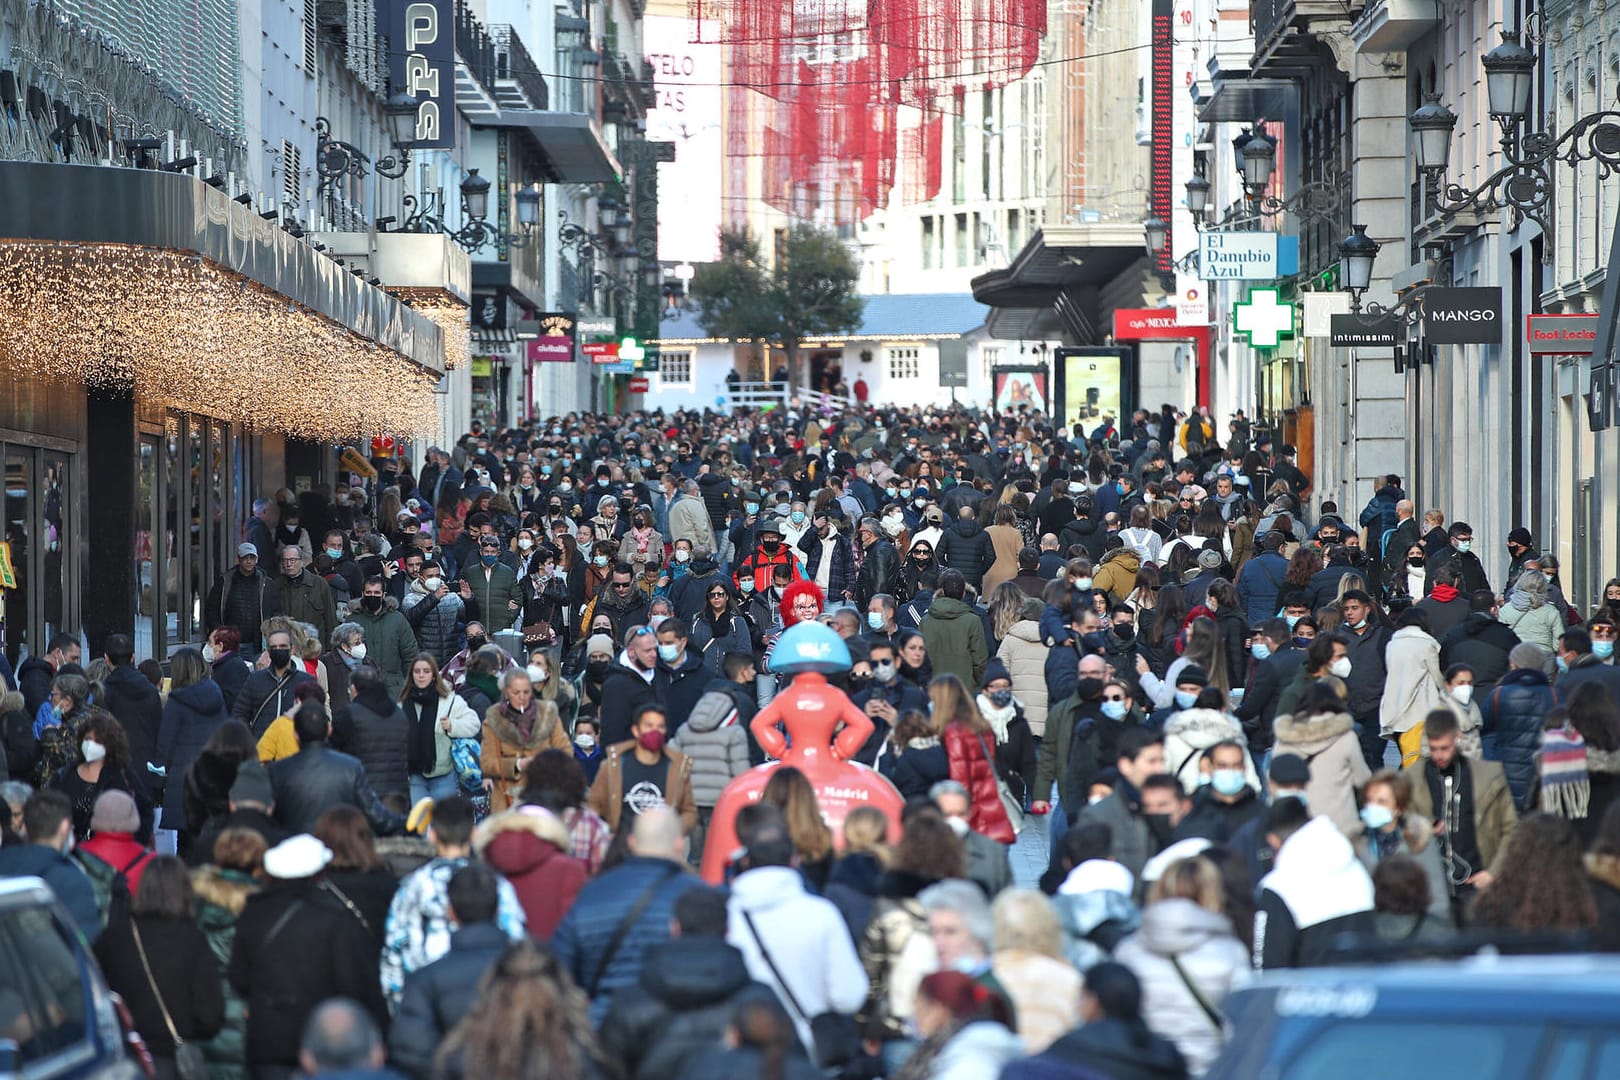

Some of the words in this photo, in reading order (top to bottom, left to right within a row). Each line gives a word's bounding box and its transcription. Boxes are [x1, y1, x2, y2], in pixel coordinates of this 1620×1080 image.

[1181, 10, 1192, 24] 10
[1207, 234, 1223, 248] El
[1207, 249, 1271, 263] Danubio
[1206, 264, 1243, 277] Azul
[1432, 309, 1495, 322] MANGO
[1333, 333, 1394, 343] intimissimi
[1534, 328, 1559, 341] Foot
[824, 785, 869, 801] Madrid
